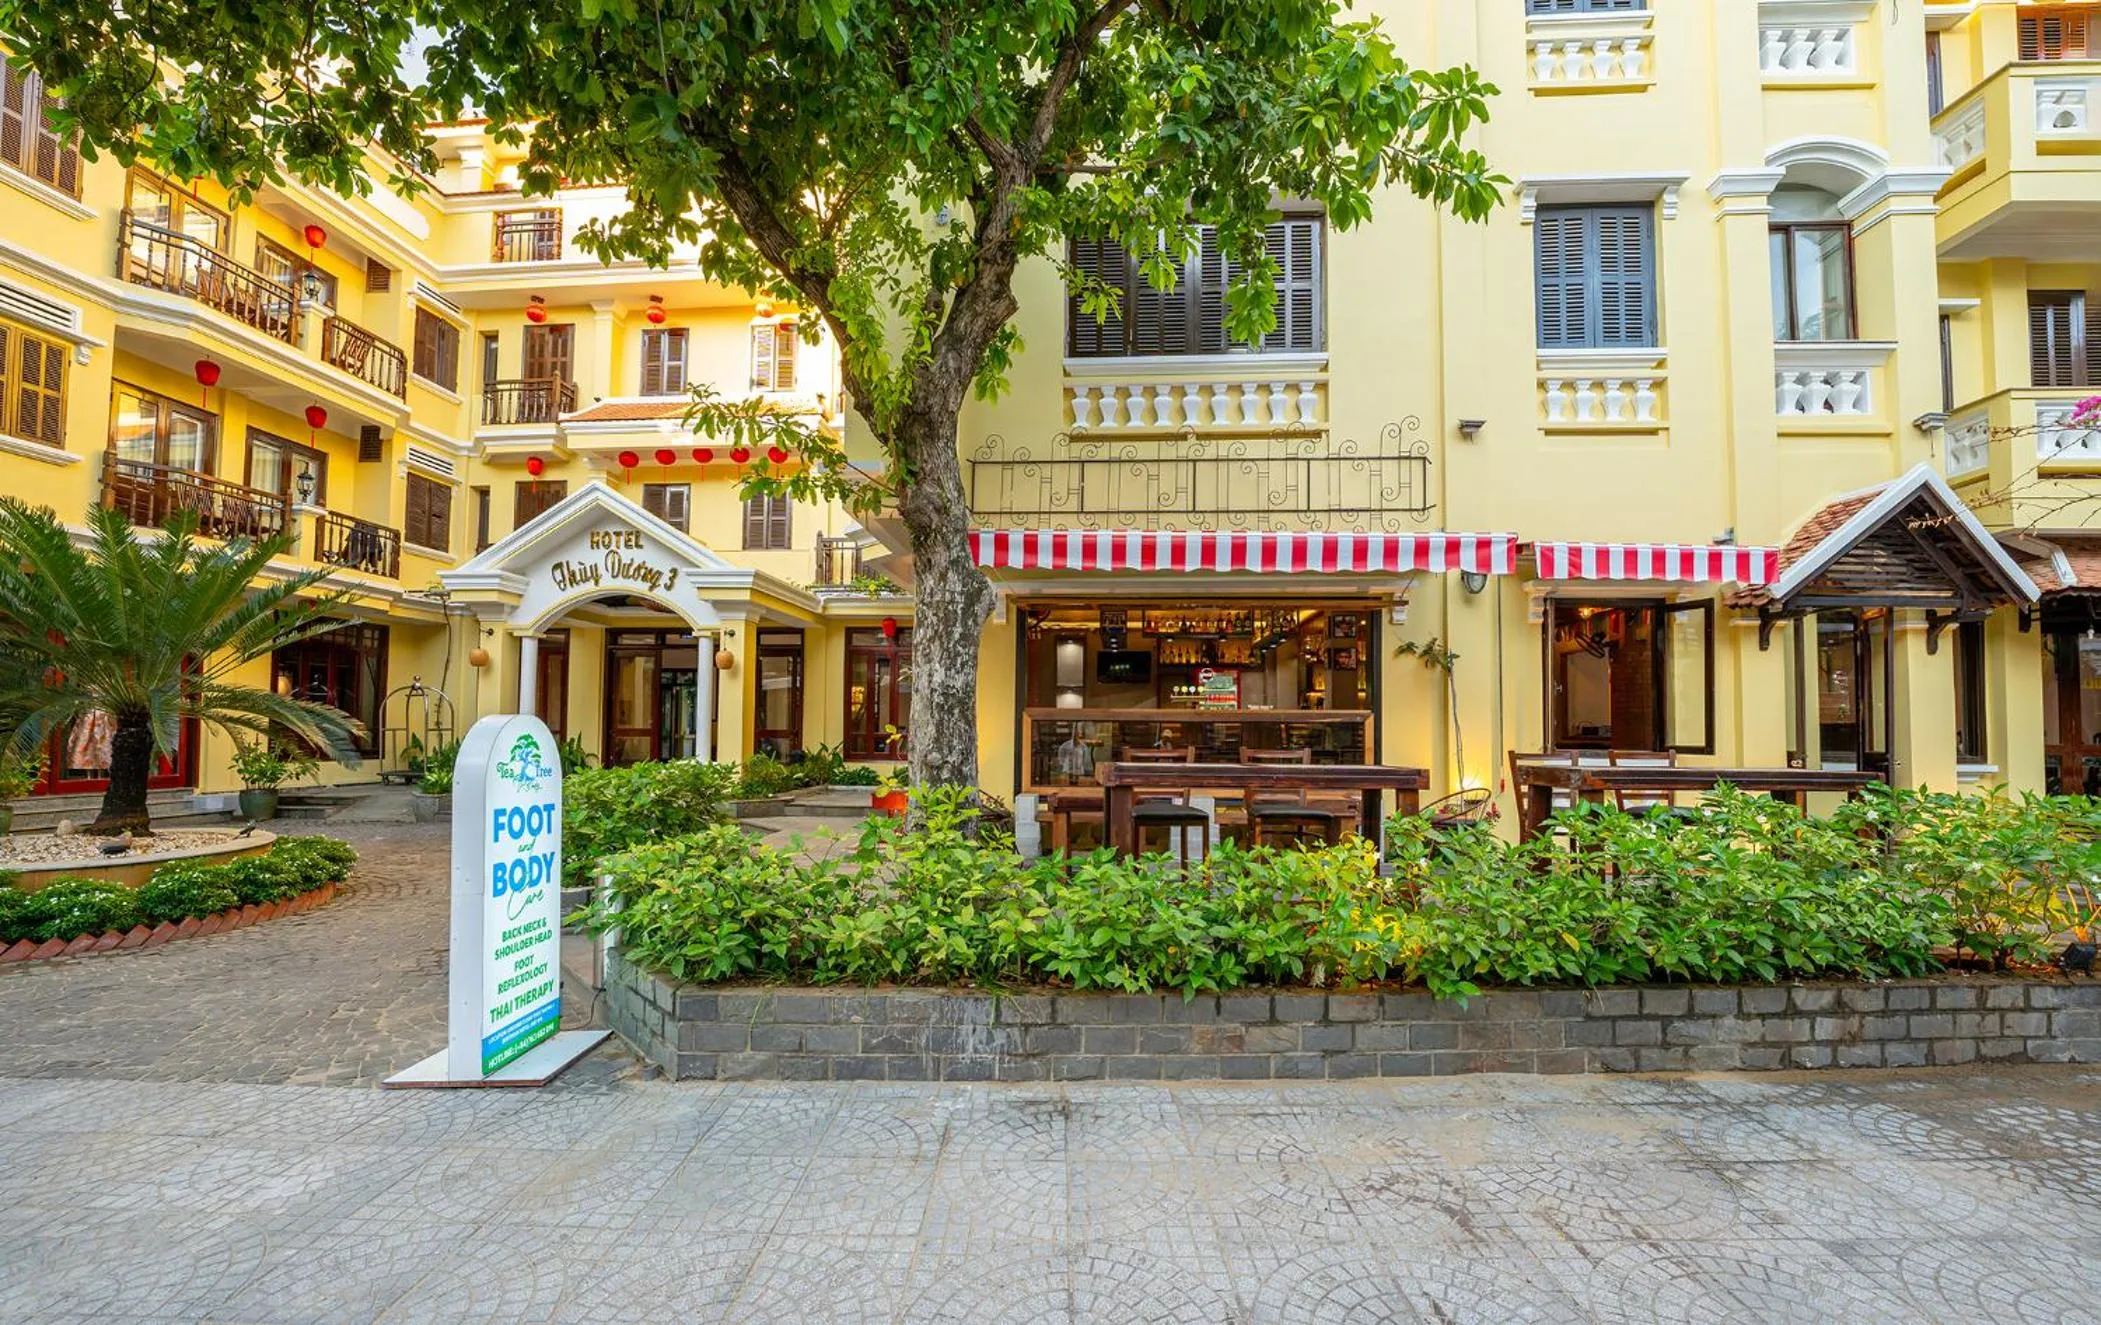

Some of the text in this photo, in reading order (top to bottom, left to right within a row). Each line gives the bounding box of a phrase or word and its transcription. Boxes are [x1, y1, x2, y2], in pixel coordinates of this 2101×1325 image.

[590, 530, 644, 550] HOTEL
[663, 567, 678, 592] 3
[496, 761, 553, 778] Tea Tree
[493, 803, 555, 843] FOOT
[518, 837, 537, 853] and
[493, 851, 555, 898] BODY
[507, 873, 544, 921] Care
[502, 917, 547, 942] BACK NECK &
[494, 929, 553, 961] SHOULDER HEAD
[514, 954, 534, 972] FOOT
[497, 961, 548, 995] REFLEXOLOGY
[490, 979, 555, 1023] THAI THERAPY
